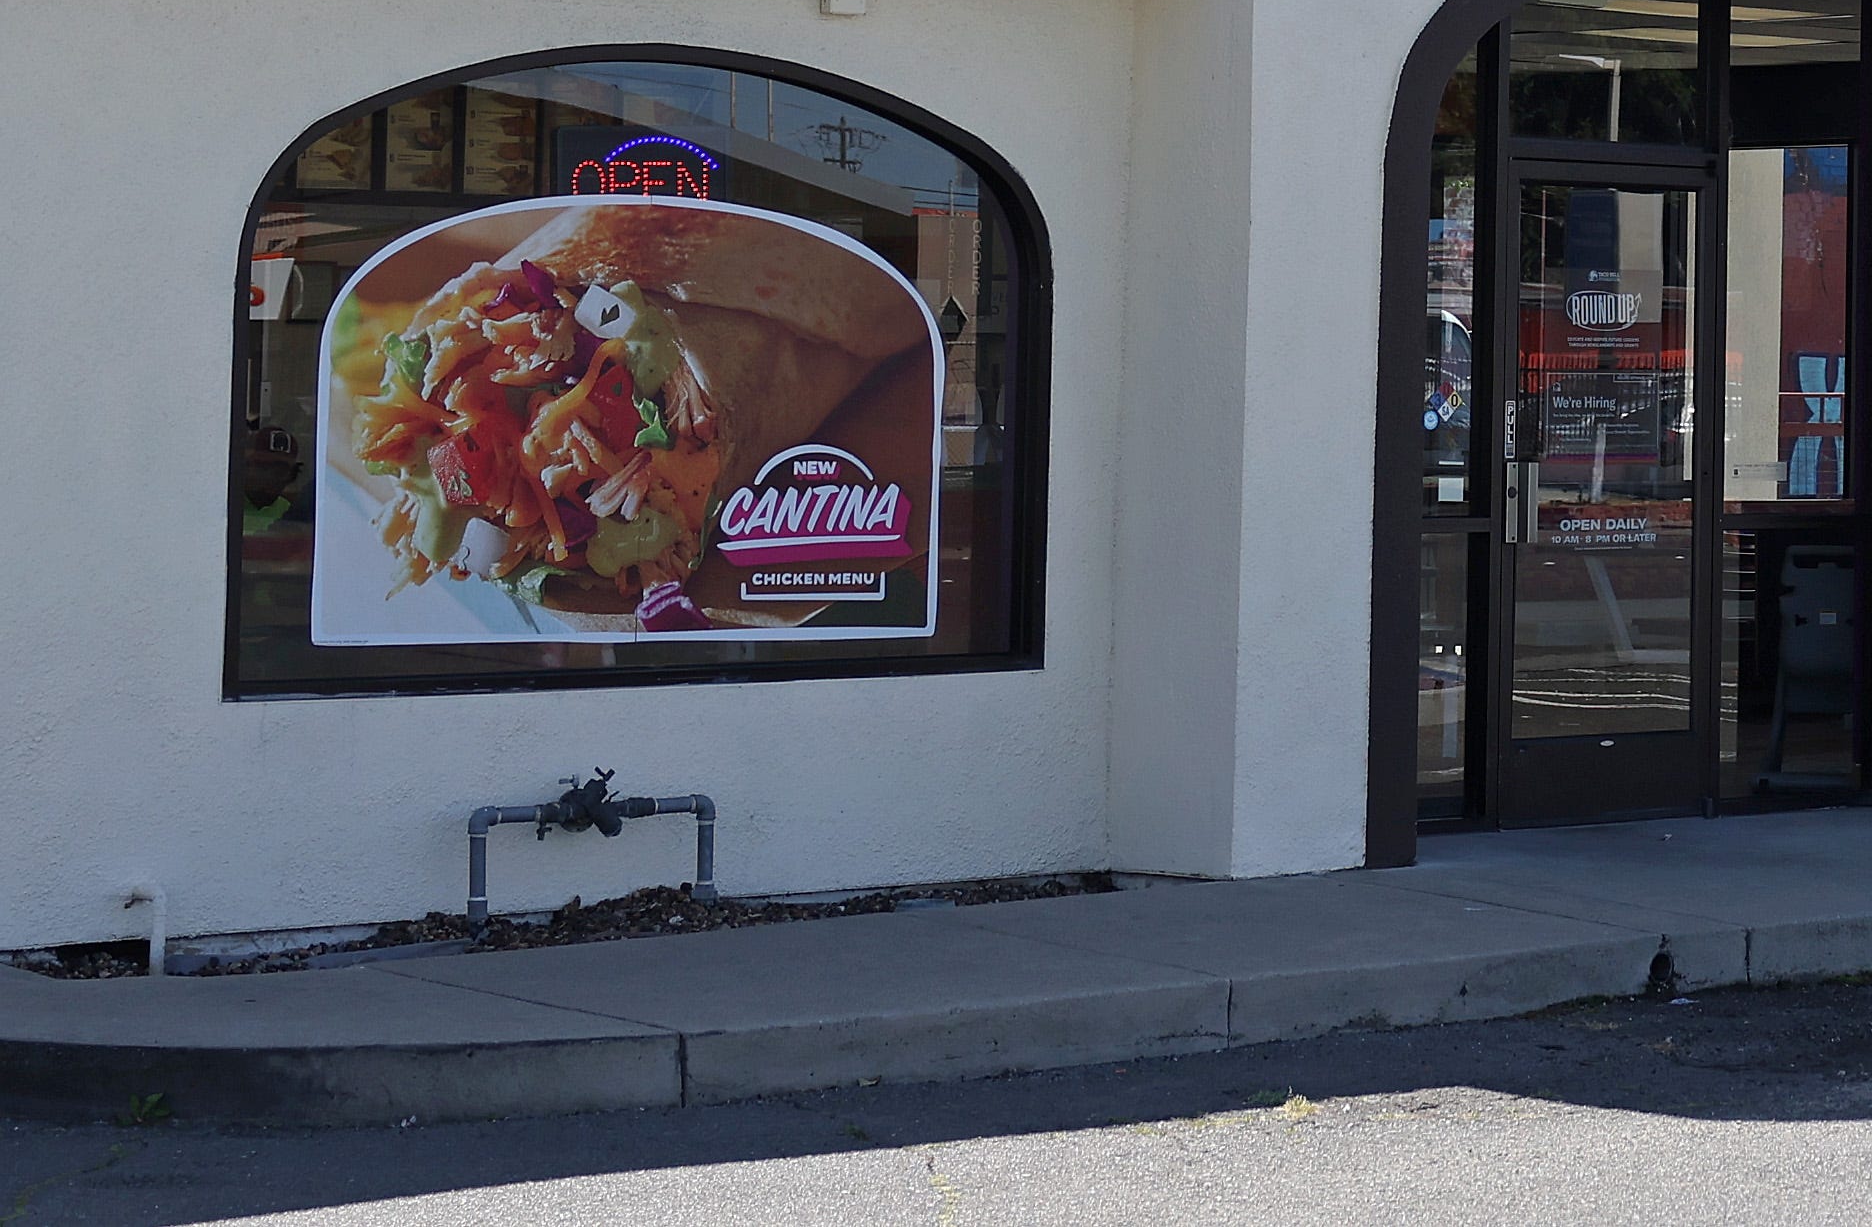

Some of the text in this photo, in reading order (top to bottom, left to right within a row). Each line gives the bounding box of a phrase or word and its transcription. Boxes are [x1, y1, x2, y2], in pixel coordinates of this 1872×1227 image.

[571, 159, 710, 201] OPEN
[972, 219, 982, 294] ORDER
[1572, 293, 1635, 325] ROUND UP
[1552, 396, 1617, 411] We're Hiring
[793, 461, 838, 475] NEW
[720, 483, 900, 536] CANTINA
[1560, 517, 1647, 531] OPEN DAILY
[1551, 536, 1561, 544] 10
[1585, 535, 1592, 543] 8
[1596, 534, 1610, 543] PM
[1612, 534, 1626, 543] OR
[1628, 533, 1657, 542] LATER
[752, 572, 875, 586] CHICKEN MENU
